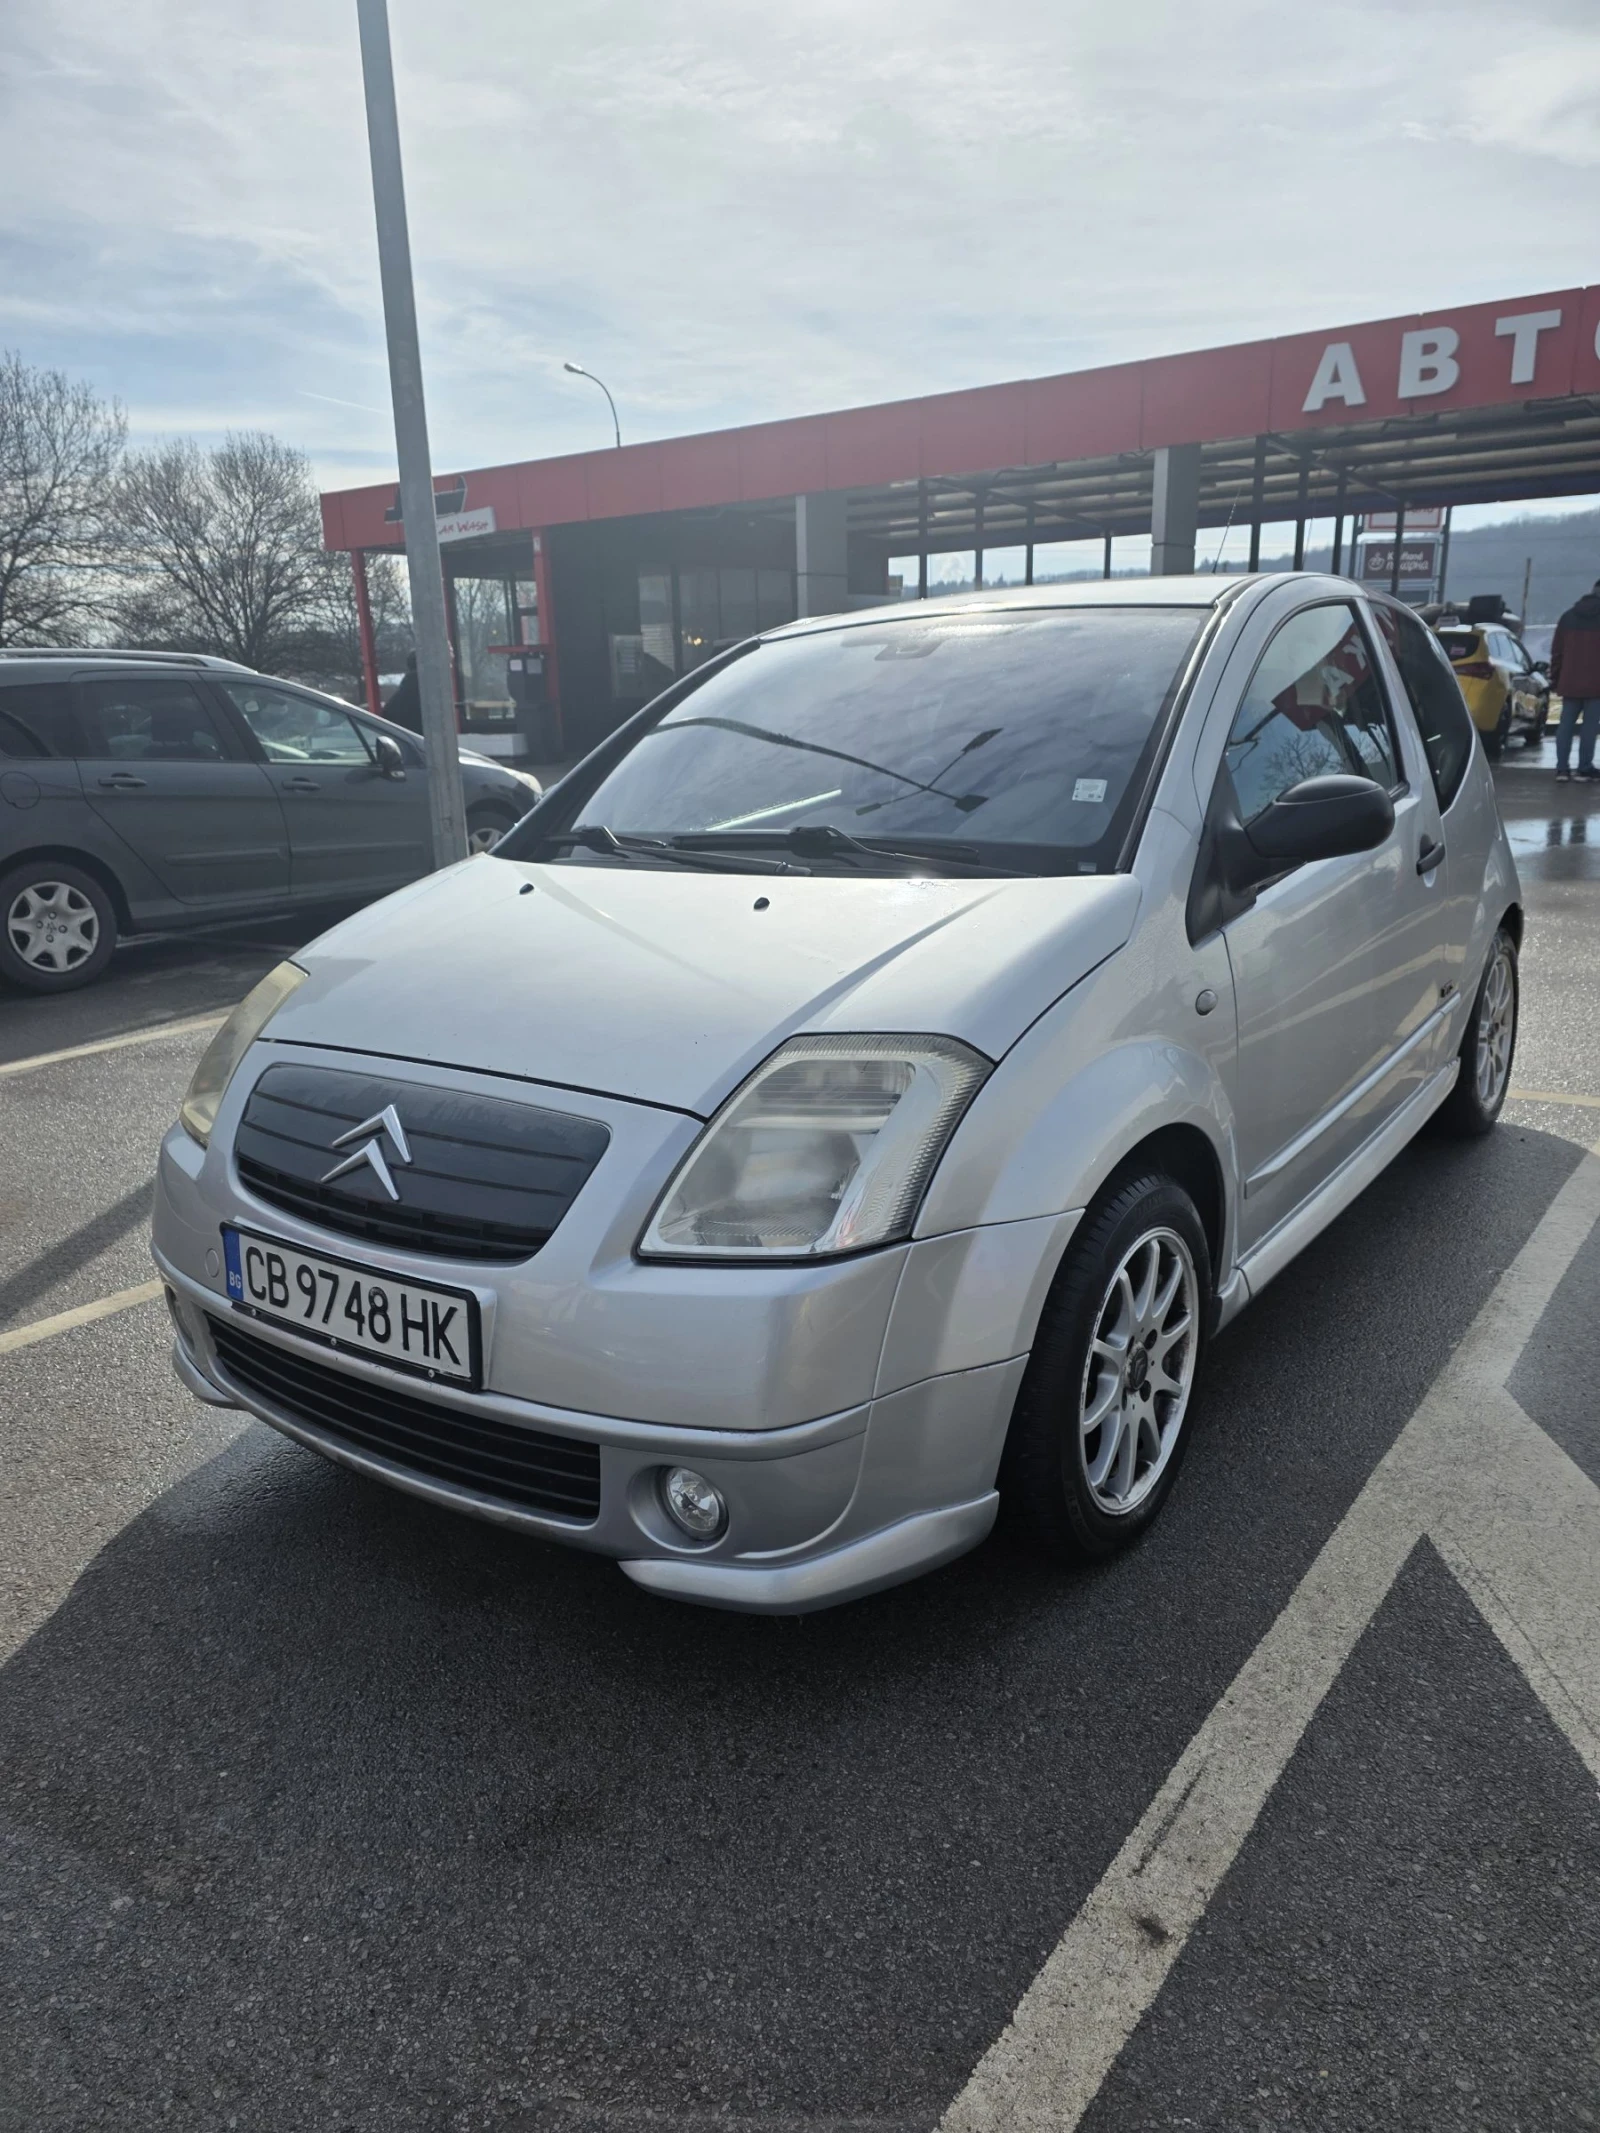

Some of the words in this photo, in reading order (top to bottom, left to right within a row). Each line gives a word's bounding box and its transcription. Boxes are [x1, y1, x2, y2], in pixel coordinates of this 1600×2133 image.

[1302, 308, 1600, 412] АВТ
[437, 523, 454, 534] AR
[229, 1271, 241, 1289] BG
[246, 1246, 289, 1308] CB
[296, 1264, 391, 1344] 9748
[401, 1293, 461, 1366] HK
